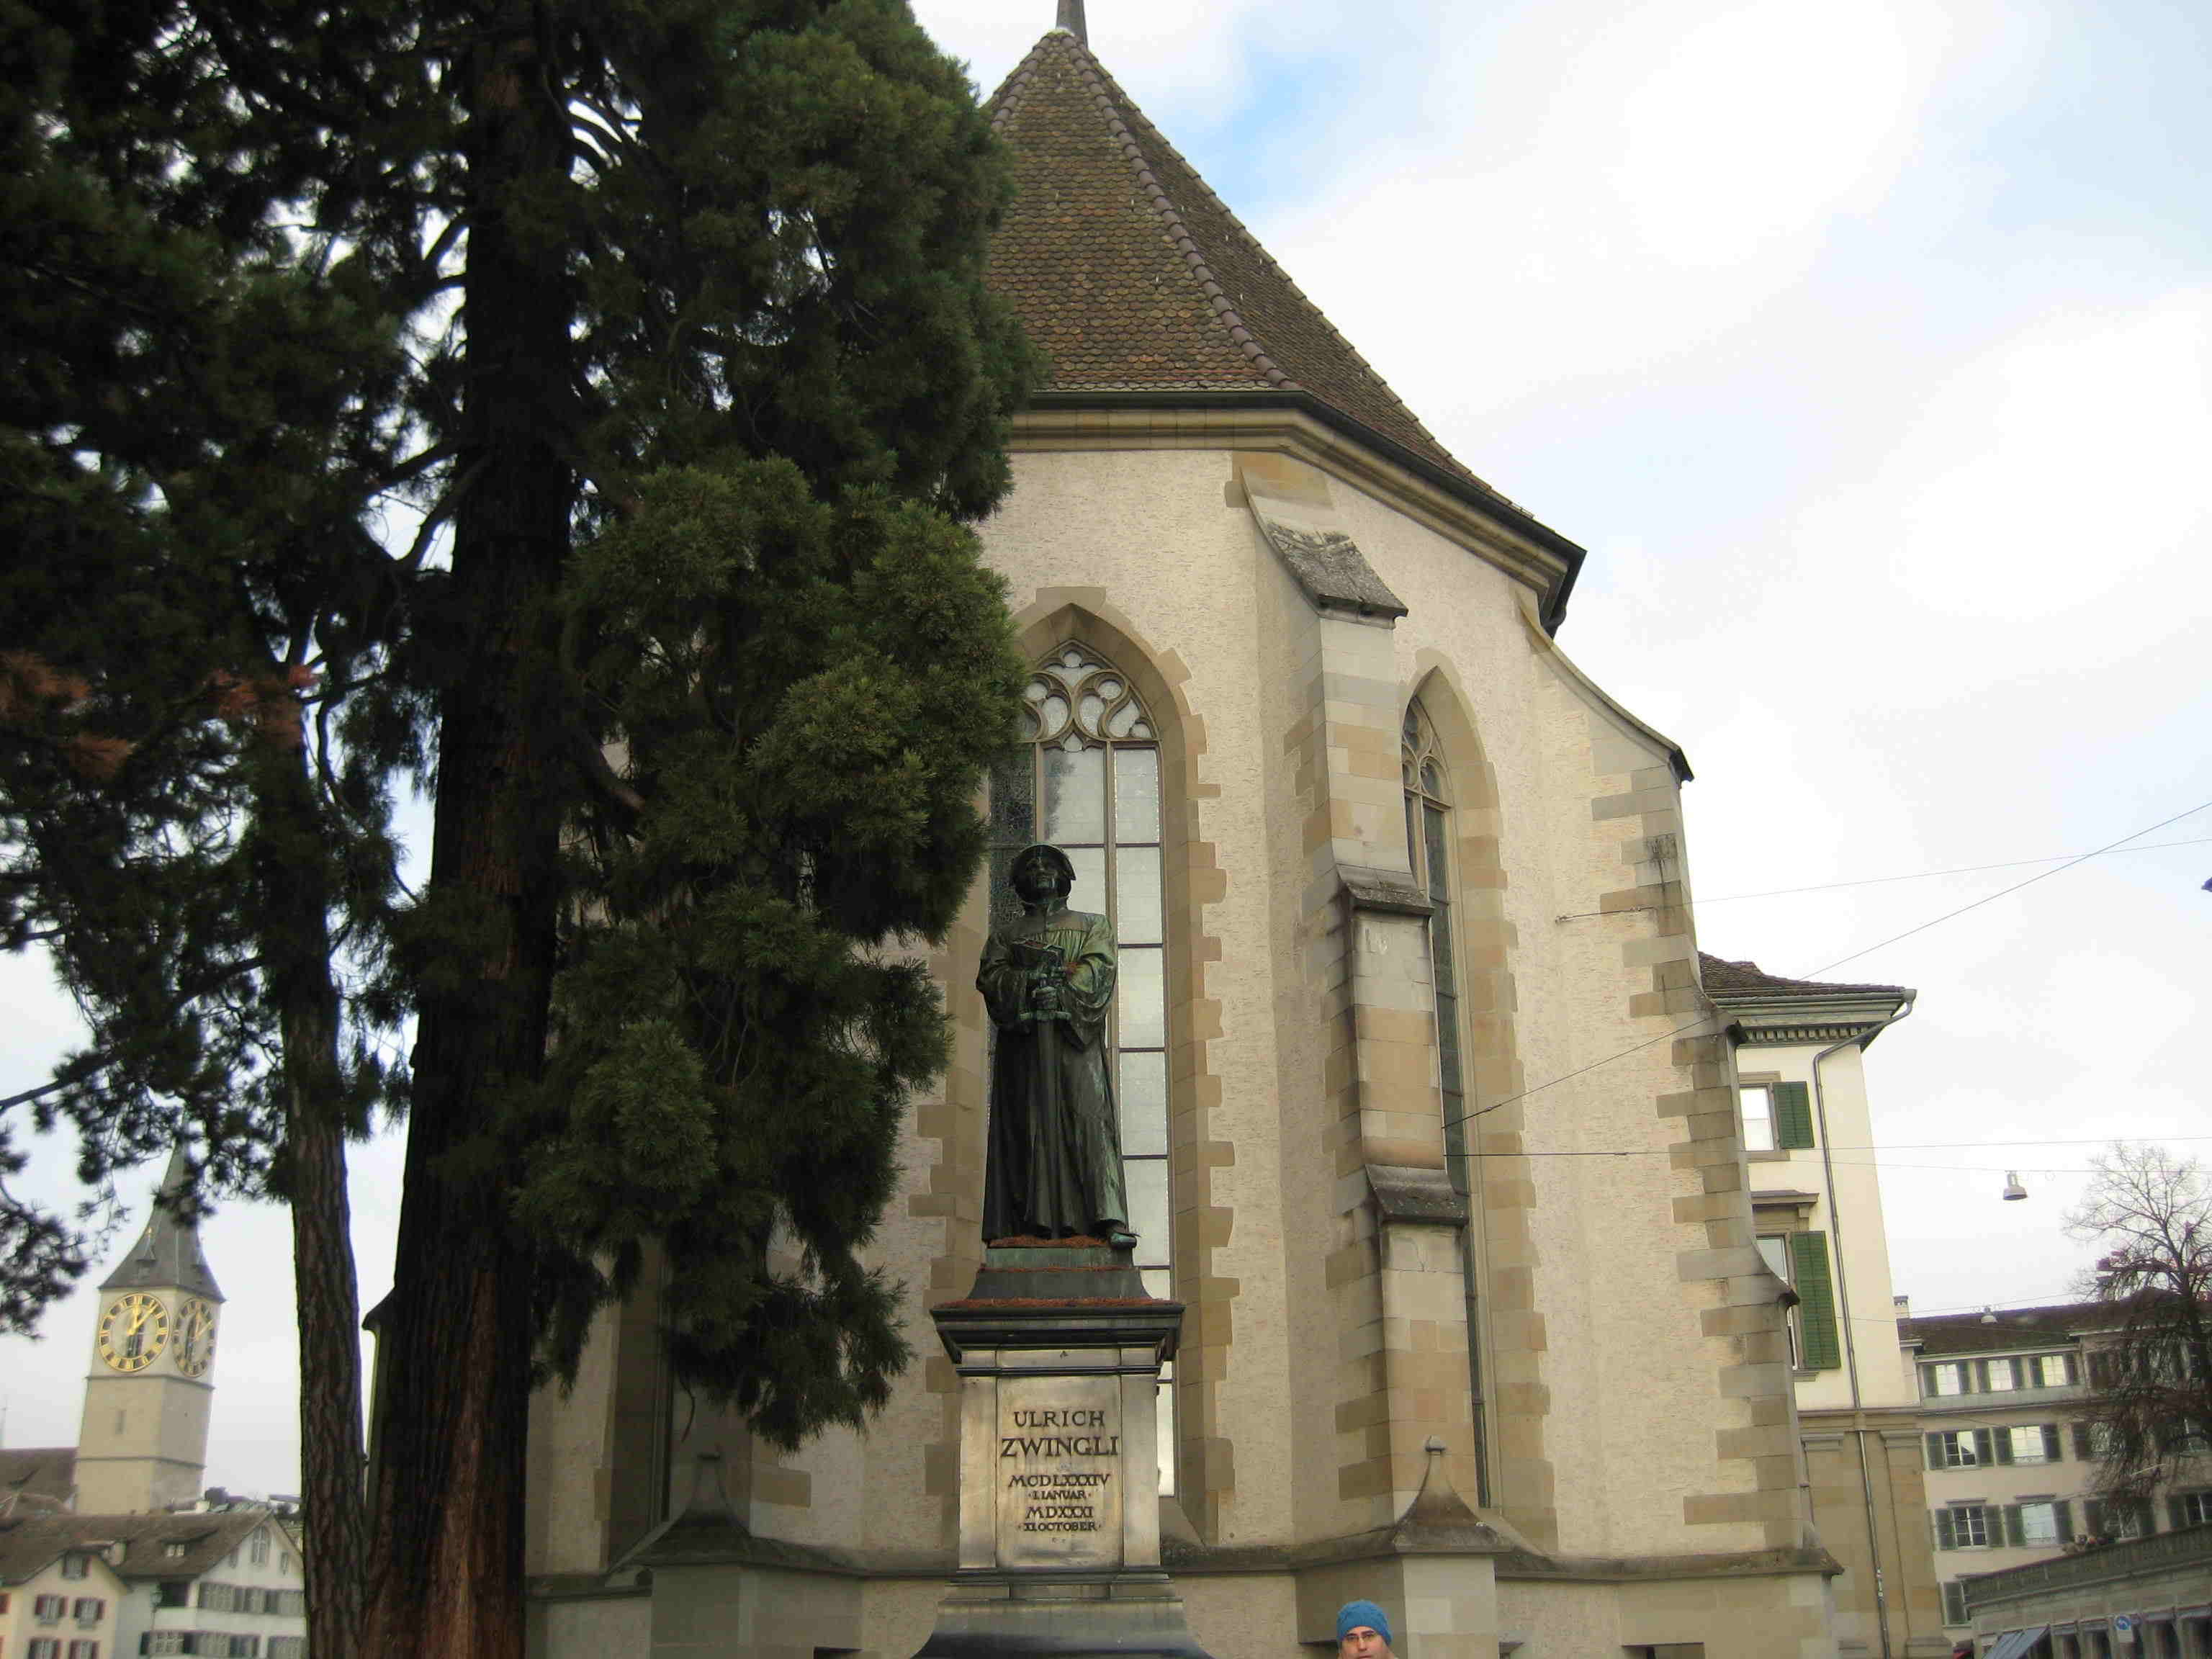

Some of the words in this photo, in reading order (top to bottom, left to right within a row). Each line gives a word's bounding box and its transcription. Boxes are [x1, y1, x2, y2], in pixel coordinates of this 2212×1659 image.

[1014, 1411, 1105, 1427] ULRICH
[1001, 1436, 1118, 1457] ZWINGLI
[1025, 1506, 1094, 1519] MDXXXI
